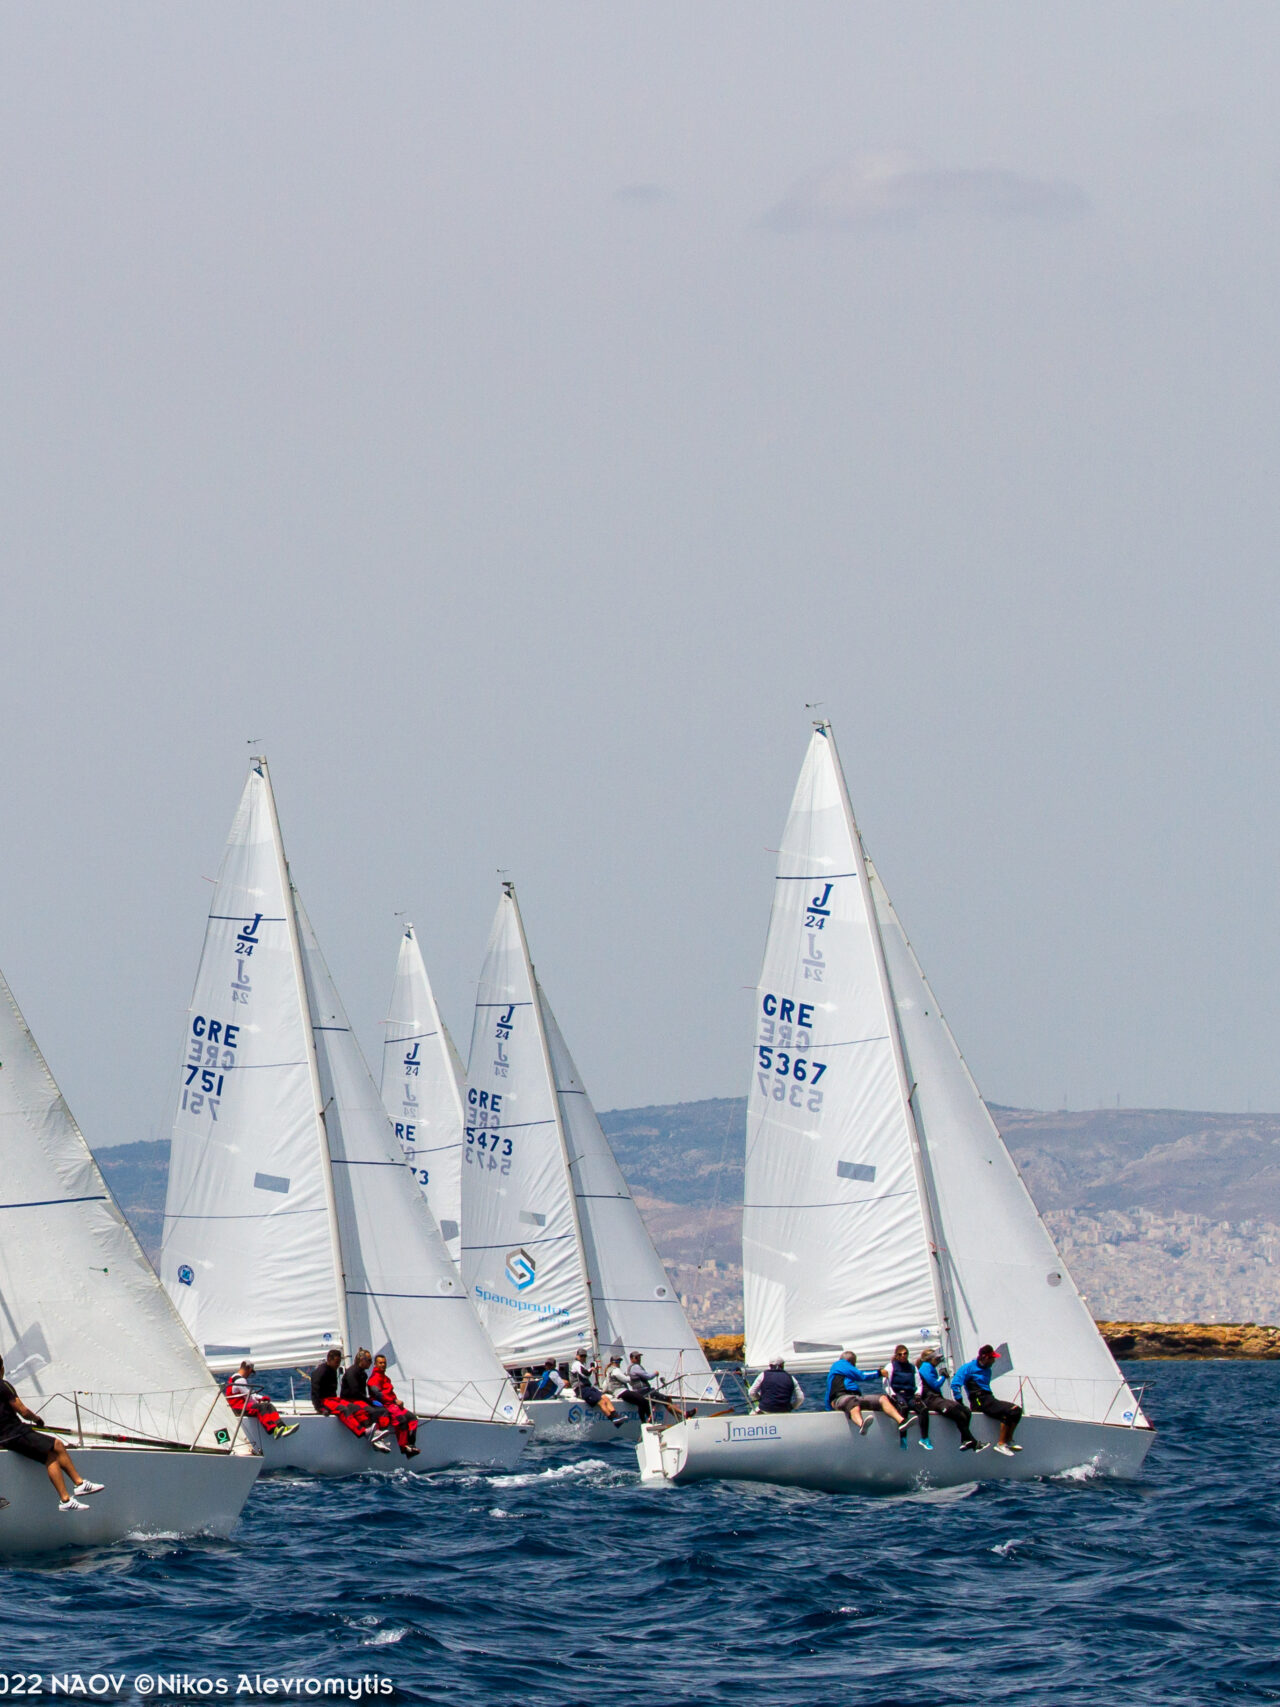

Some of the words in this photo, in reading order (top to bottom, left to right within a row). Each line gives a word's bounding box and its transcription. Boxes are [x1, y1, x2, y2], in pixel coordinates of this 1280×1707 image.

[812, 883, 834, 908] J
[242, 913, 263, 936] J
[804, 915, 825, 930] 24
[234, 942, 254, 957] 24
[500, 1004, 515, 1024] J
[762, 994, 815, 1029] GRE
[192, 1015, 240, 1049] GRE
[495, 1029, 510, 1040] 24
[406, 1042, 420, 1060] J
[405, 1066, 419, 1077] 24
[758, 1046, 827, 1085] 5367
[184, 1064, 224, 1097] 751
[468, 1087, 502, 1113] GRE
[394, 1122, 416, 1142] RE
[466, 1126, 513, 1156] 5473
[475, 1285, 570, 1317] Spanopoulos
[723, 1421, 777, 1442] Jmania
